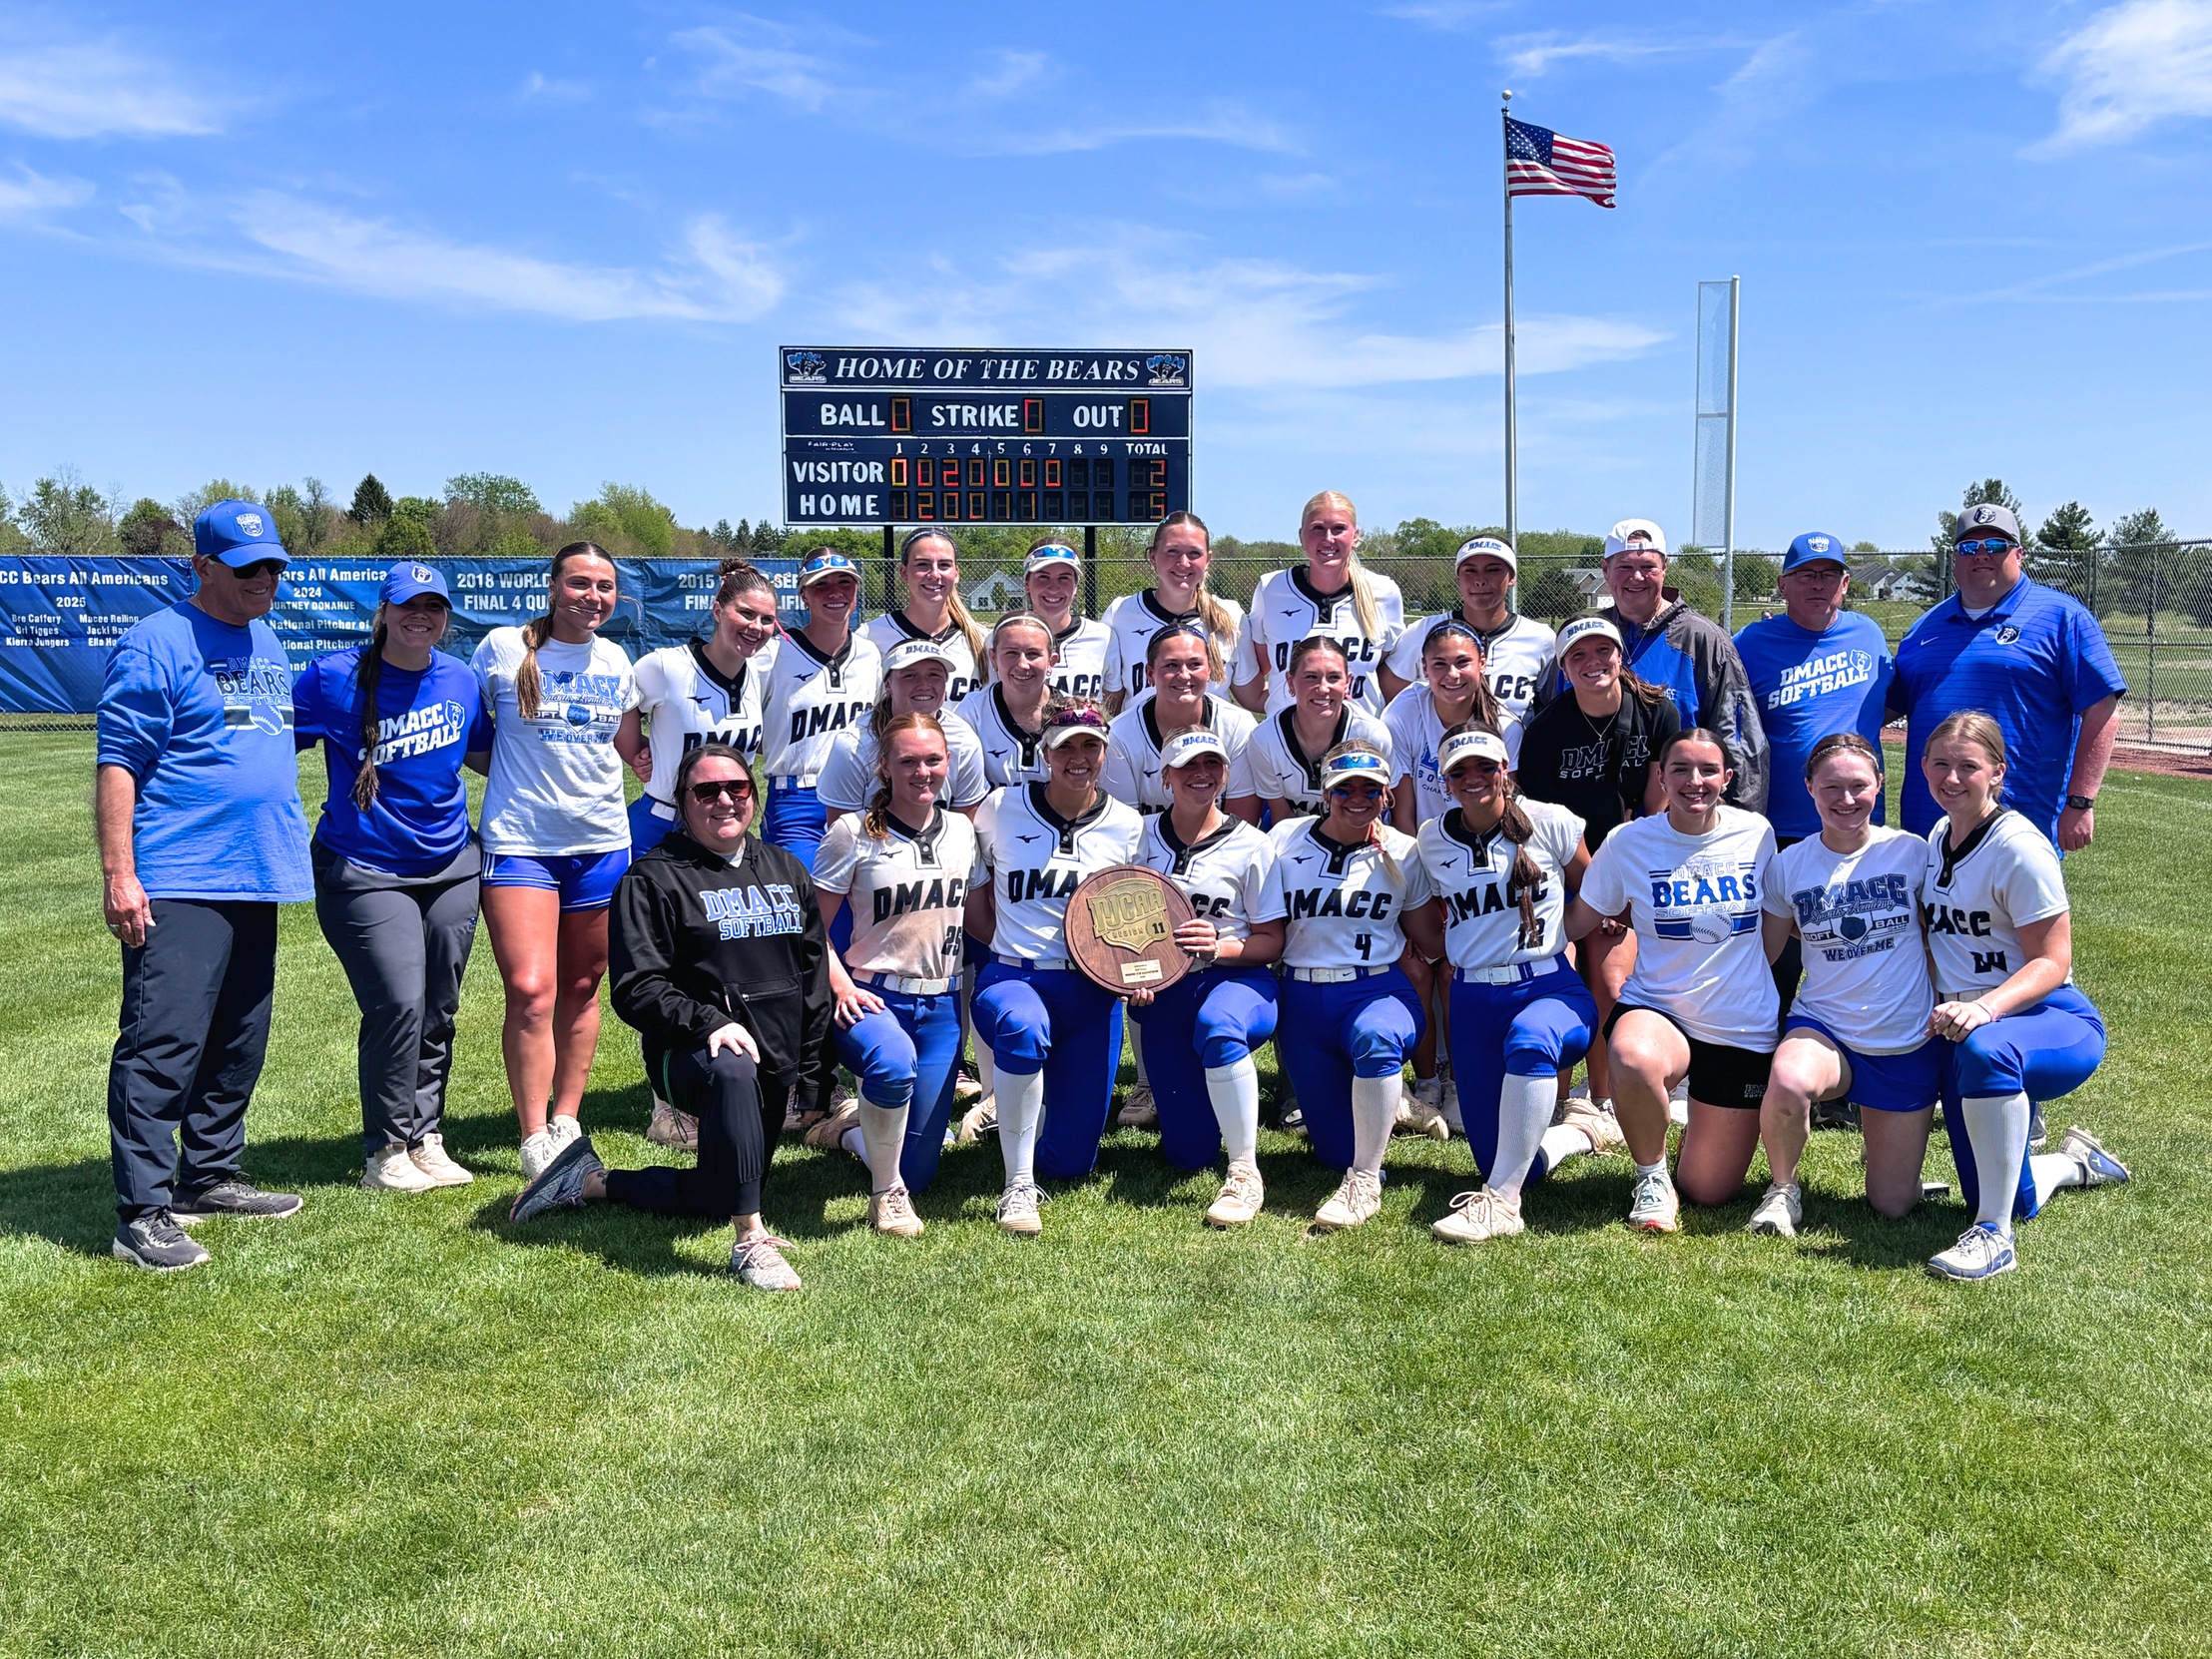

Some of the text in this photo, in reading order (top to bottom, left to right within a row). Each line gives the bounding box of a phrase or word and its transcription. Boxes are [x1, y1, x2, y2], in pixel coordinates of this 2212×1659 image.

[834, 357, 1140, 381] HOME OF THE BEARS
[820, 398, 1149, 433] BALL 0 STRIKE 0 OUT 0
[895, 442, 1169, 455] 1 2 3 4 5 6 7 8 9 TOTAL
[792, 458, 1165, 487] VISITOR 0 0 2 0 0 0 0 2
[800, 494, 880, 516] HOME
[917, 491, 934, 520] 2
[943, 491, 959, 520] 0
[969, 491, 985, 520] 0
[1150, 491, 1165, 520] 5
[23, 571, 66, 585] Bears
[69, 571, 88, 585] All
[91, 572, 169, 586] Americans
[277, 568, 387, 582] ars All America
[457, 573, 552, 589] 2018 WORLD
[678, 573, 716, 589] 2015
[56, 597, 87, 608] 2025
[293, 587, 322, 598] 2024
[464, 595, 508, 610] FINAL
[511, 595, 522, 610] 4
[311, 601, 355, 611] DONAHUE
[316, 620, 356, 630] Pitcher
[358, 619, 370, 630] of
[282, 639, 313, 650] tional
[315, 639, 355, 650] Pitcher
[1779, 651, 1849, 688] DMACC
[214, 669, 290, 696] BEARS
[539, 670, 623, 711] MACC
[1768, 667, 1870, 711] SOFTBALL
[1008, 868, 1079, 903] DMA
[1651, 873, 1757, 908] BEARS
[699, 883, 801, 922] DMACC
[1091, 888, 1164, 933] NJCAA
[1654, 900, 1759, 918] SOFTBALL
[1792, 873, 1911, 928] DMACC
[719, 912, 804, 940] SOFTBALL
[1152, 921, 1166, 934] 11
[1875, 916, 1909, 928] BALL
[1922, 902, 1991, 937] MACC
[1355, 933, 1373, 960] 4
[1822, 938, 1896, 962] WE OVER ME
